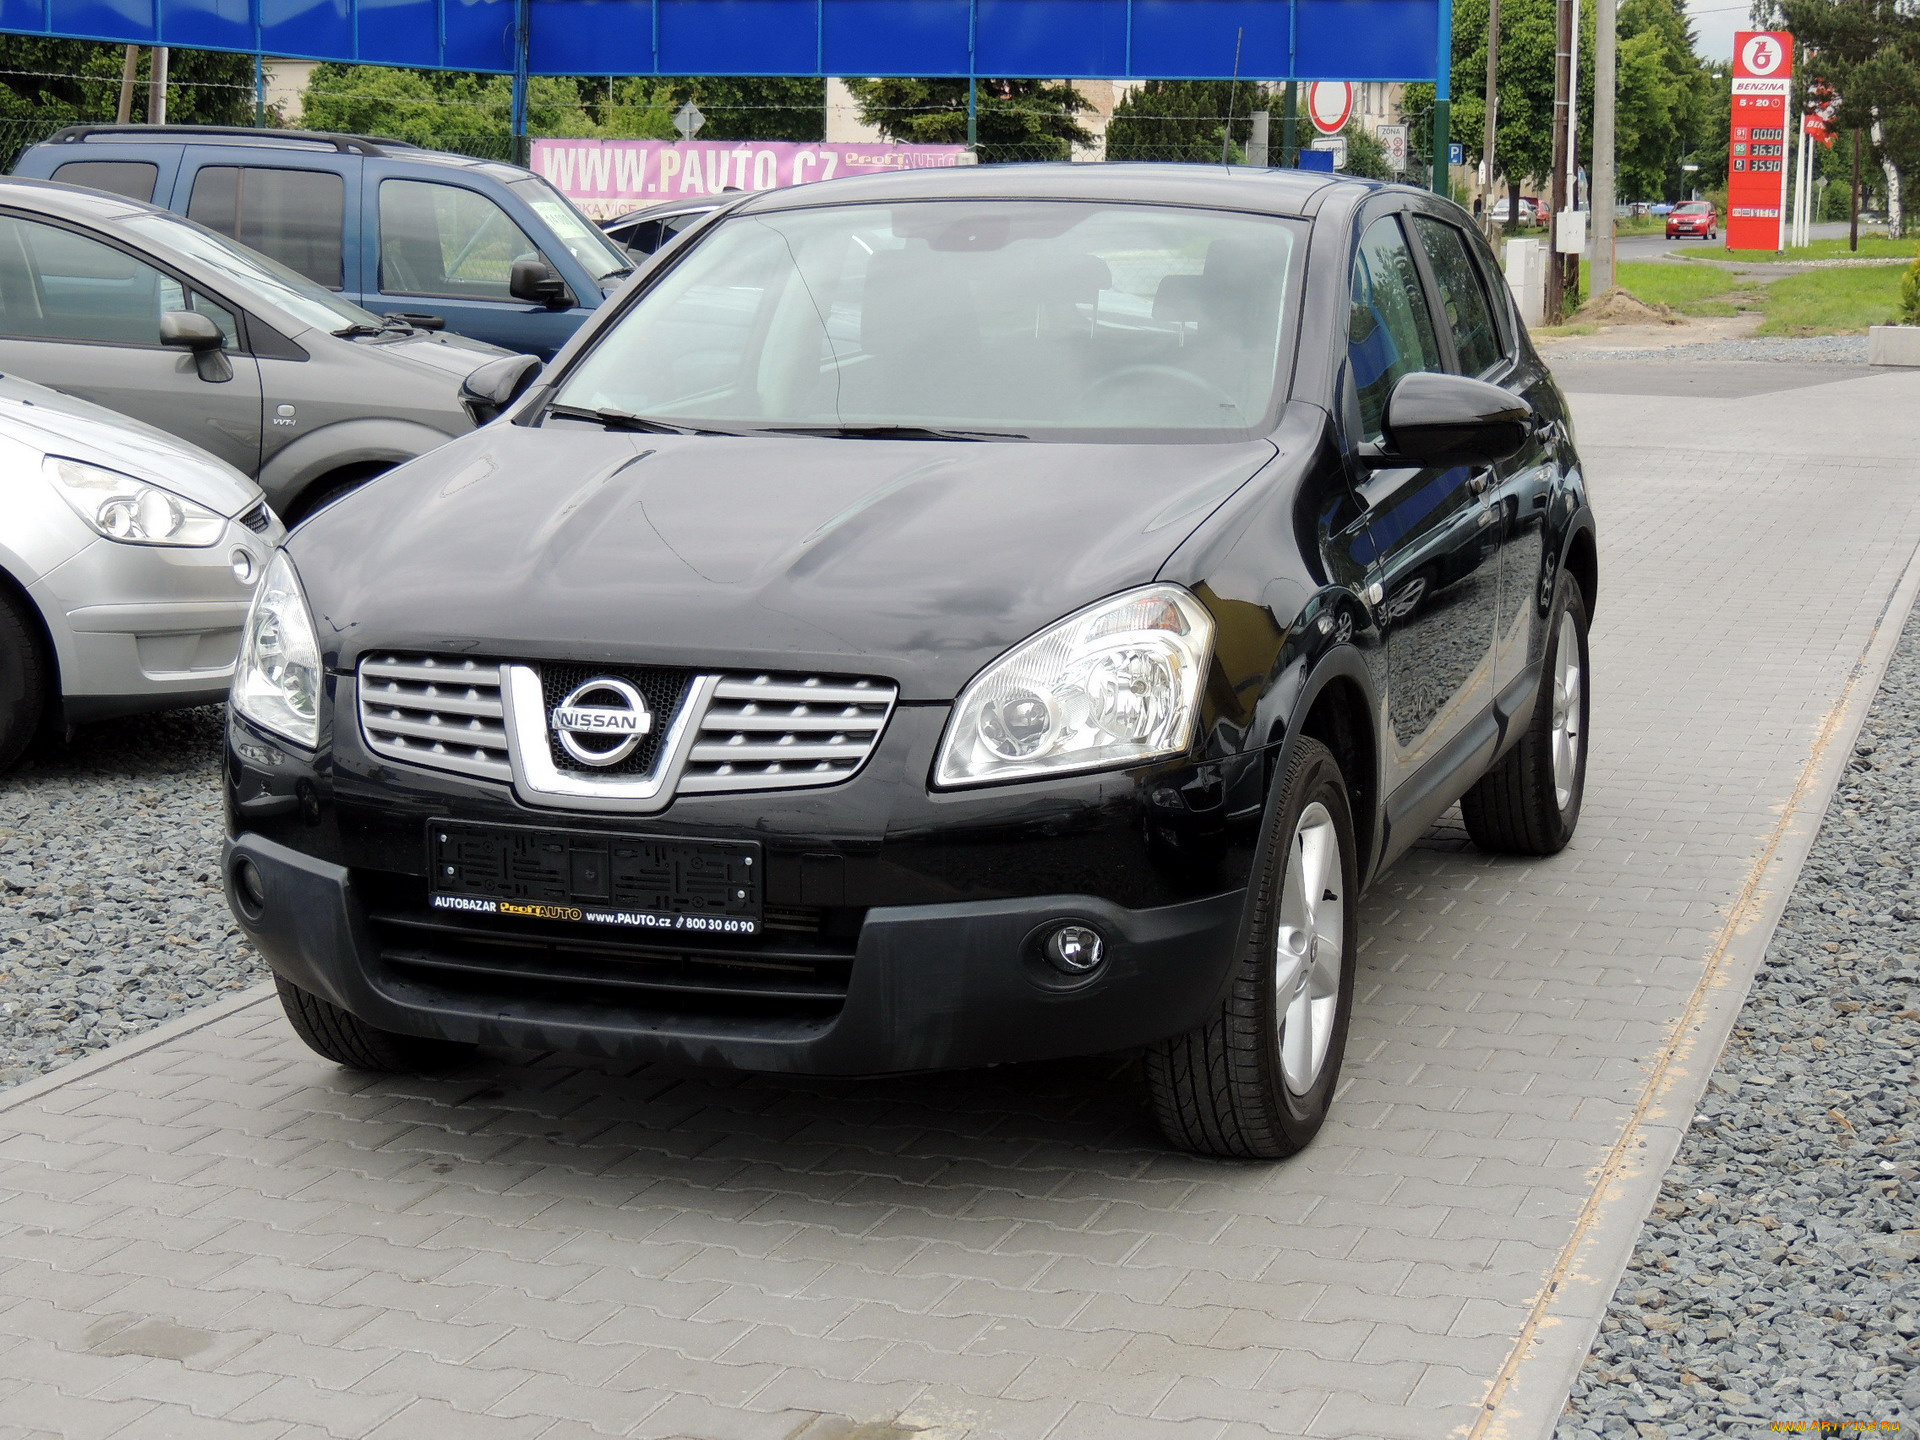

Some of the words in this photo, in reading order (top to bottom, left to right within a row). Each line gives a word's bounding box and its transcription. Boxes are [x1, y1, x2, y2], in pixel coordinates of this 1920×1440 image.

[1736, 82, 1784, 91] BENZINA
[1450, 146, 1460, 159] P
[1736, 160, 1742, 168] D
[1751, 160, 1781, 172] 35.90
[561, 713, 637, 729] NISSAN
[434, 896, 497, 912] AUTOBAZAR
[586, 912, 671, 927] www.PAUTO.cz
[686, 917, 707, 930] 800
[708, 919, 722, 931] 30
[724, 920, 738, 932] 60
[740, 921, 754, 933] 90
